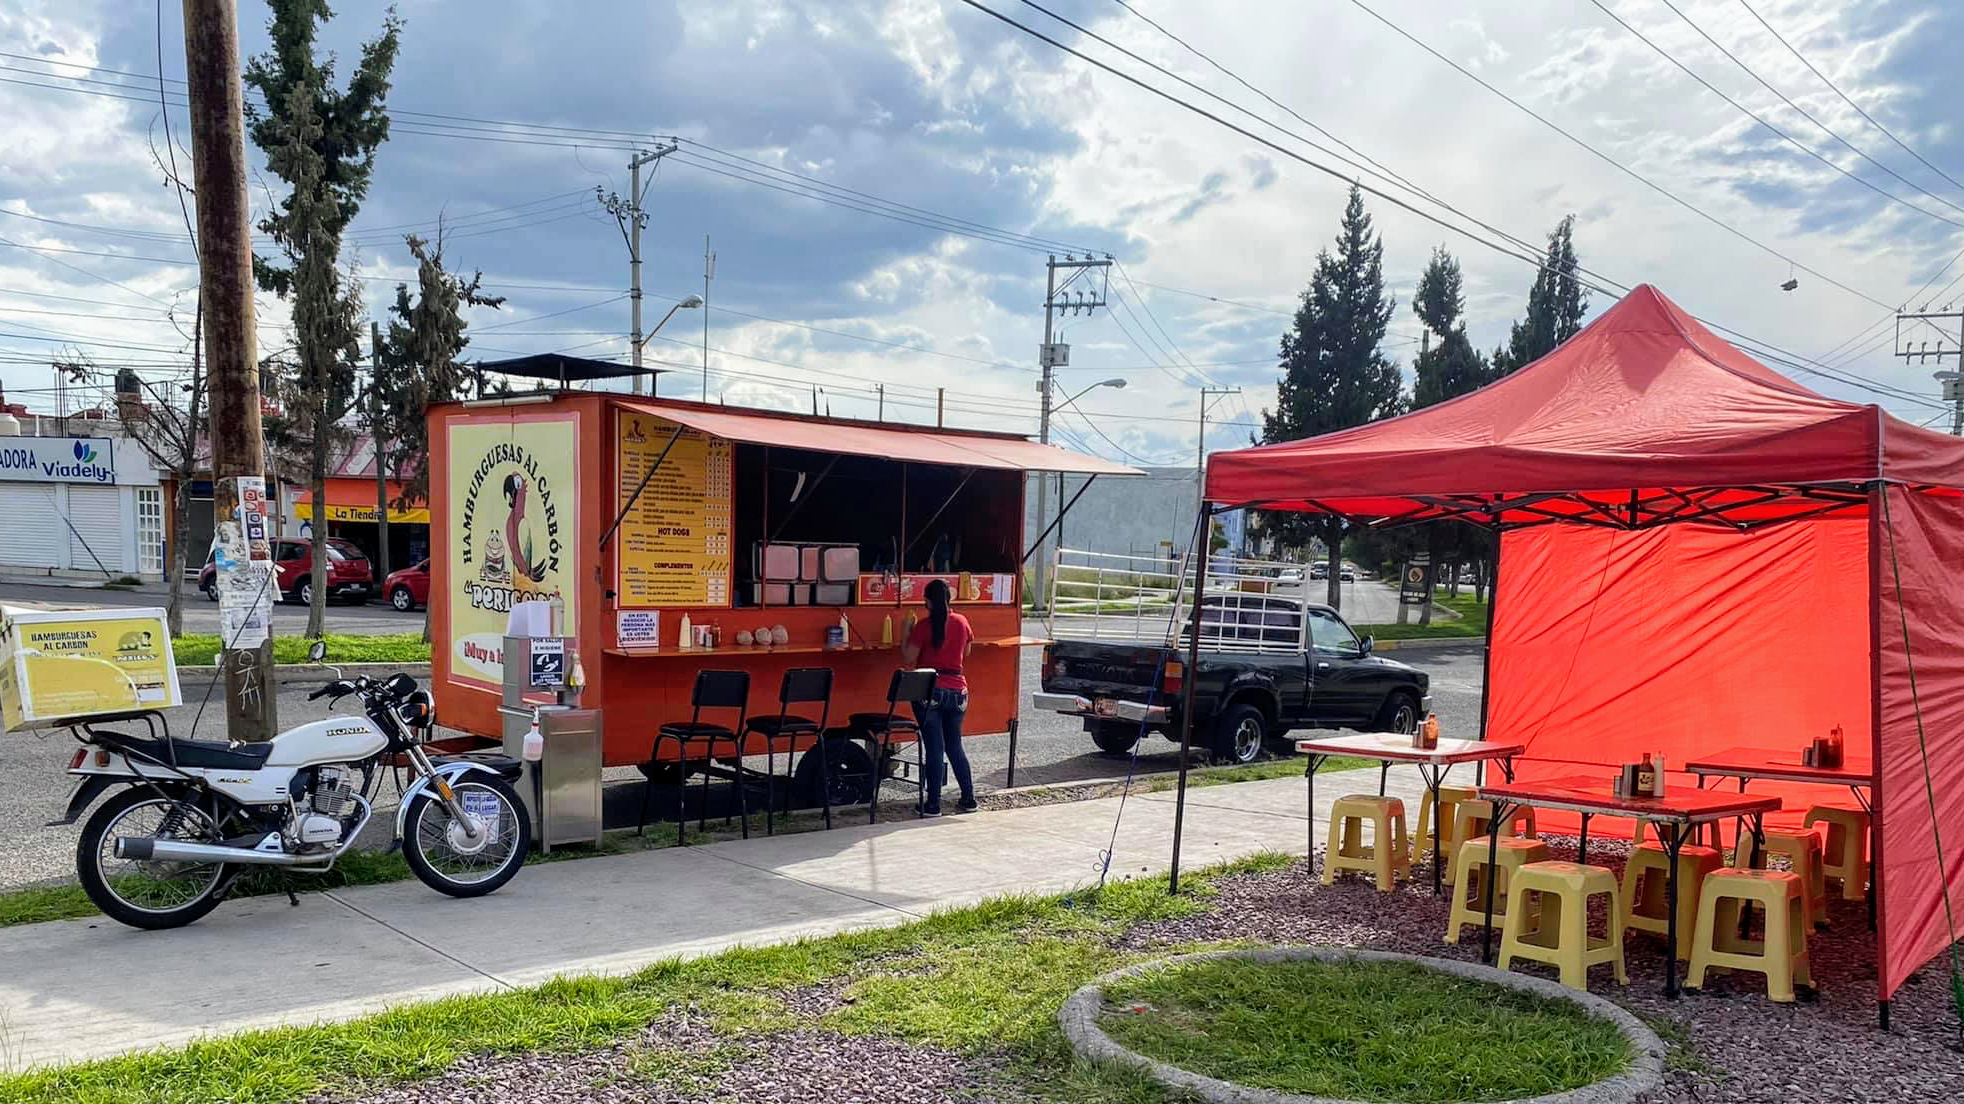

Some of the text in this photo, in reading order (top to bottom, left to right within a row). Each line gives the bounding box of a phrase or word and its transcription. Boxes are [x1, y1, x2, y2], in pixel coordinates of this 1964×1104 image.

[42, 460, 110, 482] Viadely
[335, 508, 347, 519] La
[462, 443, 524, 565] HAMBURGUESAS
[523, 454, 538, 482] AL
[538, 476, 563, 573] CARBÓN
[657, 527, 690, 537] HOT DOGS
[31, 630, 97, 642] HAMBURGUESAS
[326, 726, 372, 737] HONDA
